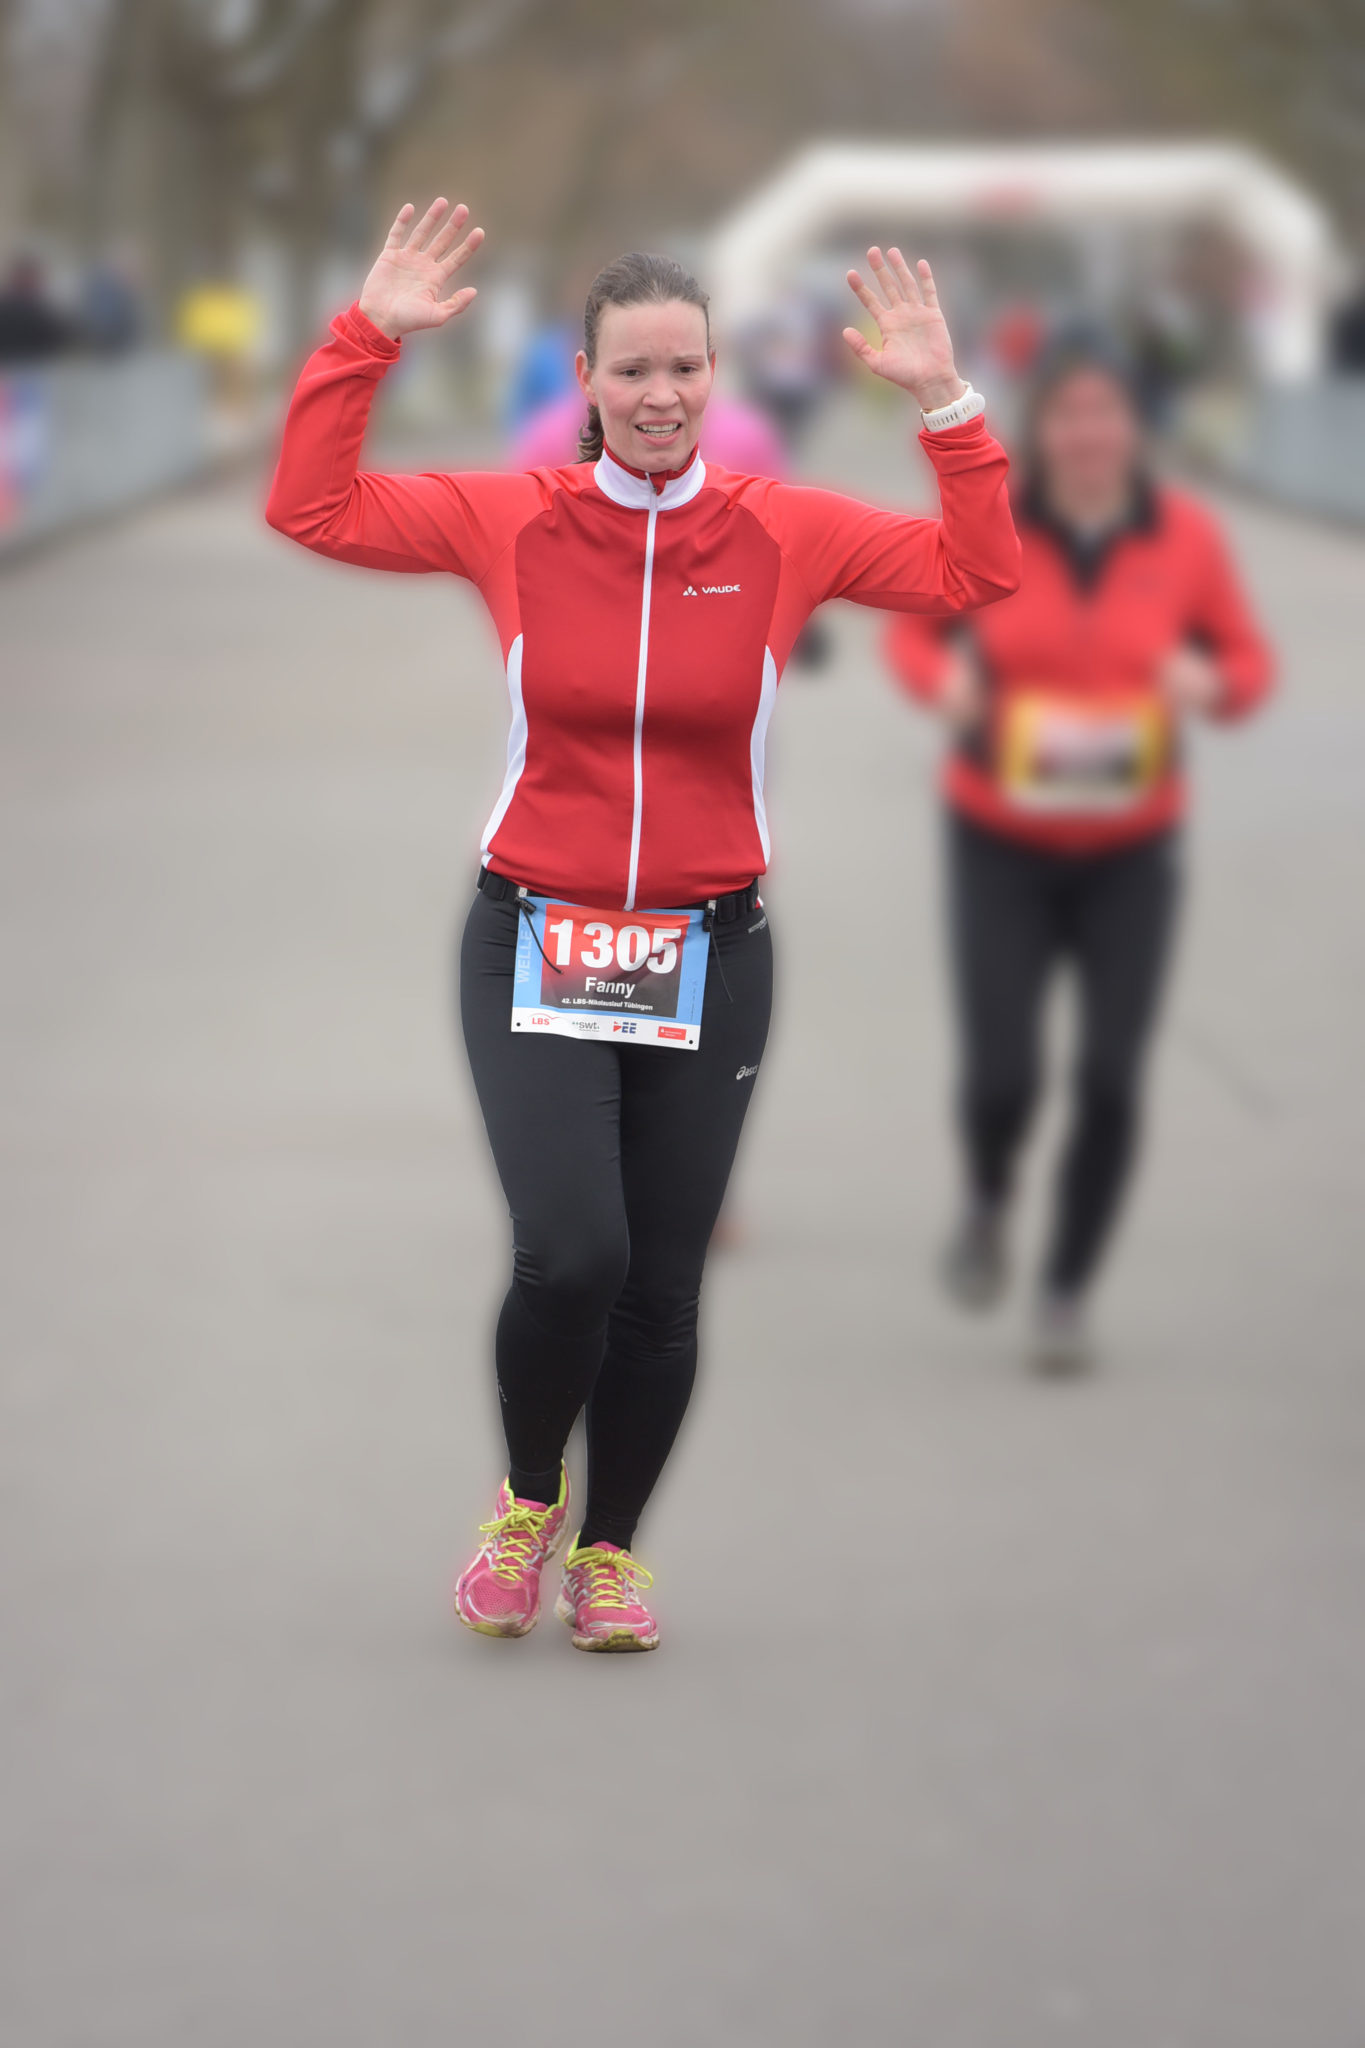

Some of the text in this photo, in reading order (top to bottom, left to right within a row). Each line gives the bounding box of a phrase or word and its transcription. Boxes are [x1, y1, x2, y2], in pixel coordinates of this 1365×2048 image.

[701, 584, 741, 594] VAUDE
[549, 918, 682, 975] 1305
[516, 929, 532, 984] WELLE
[585, 976, 636, 999] Fanny
[572, 997, 623, 1008] LBS-Nikolauslauf
[624, 1001, 654, 1011] Tübingen
[531, 1016, 550, 1026] LBS
